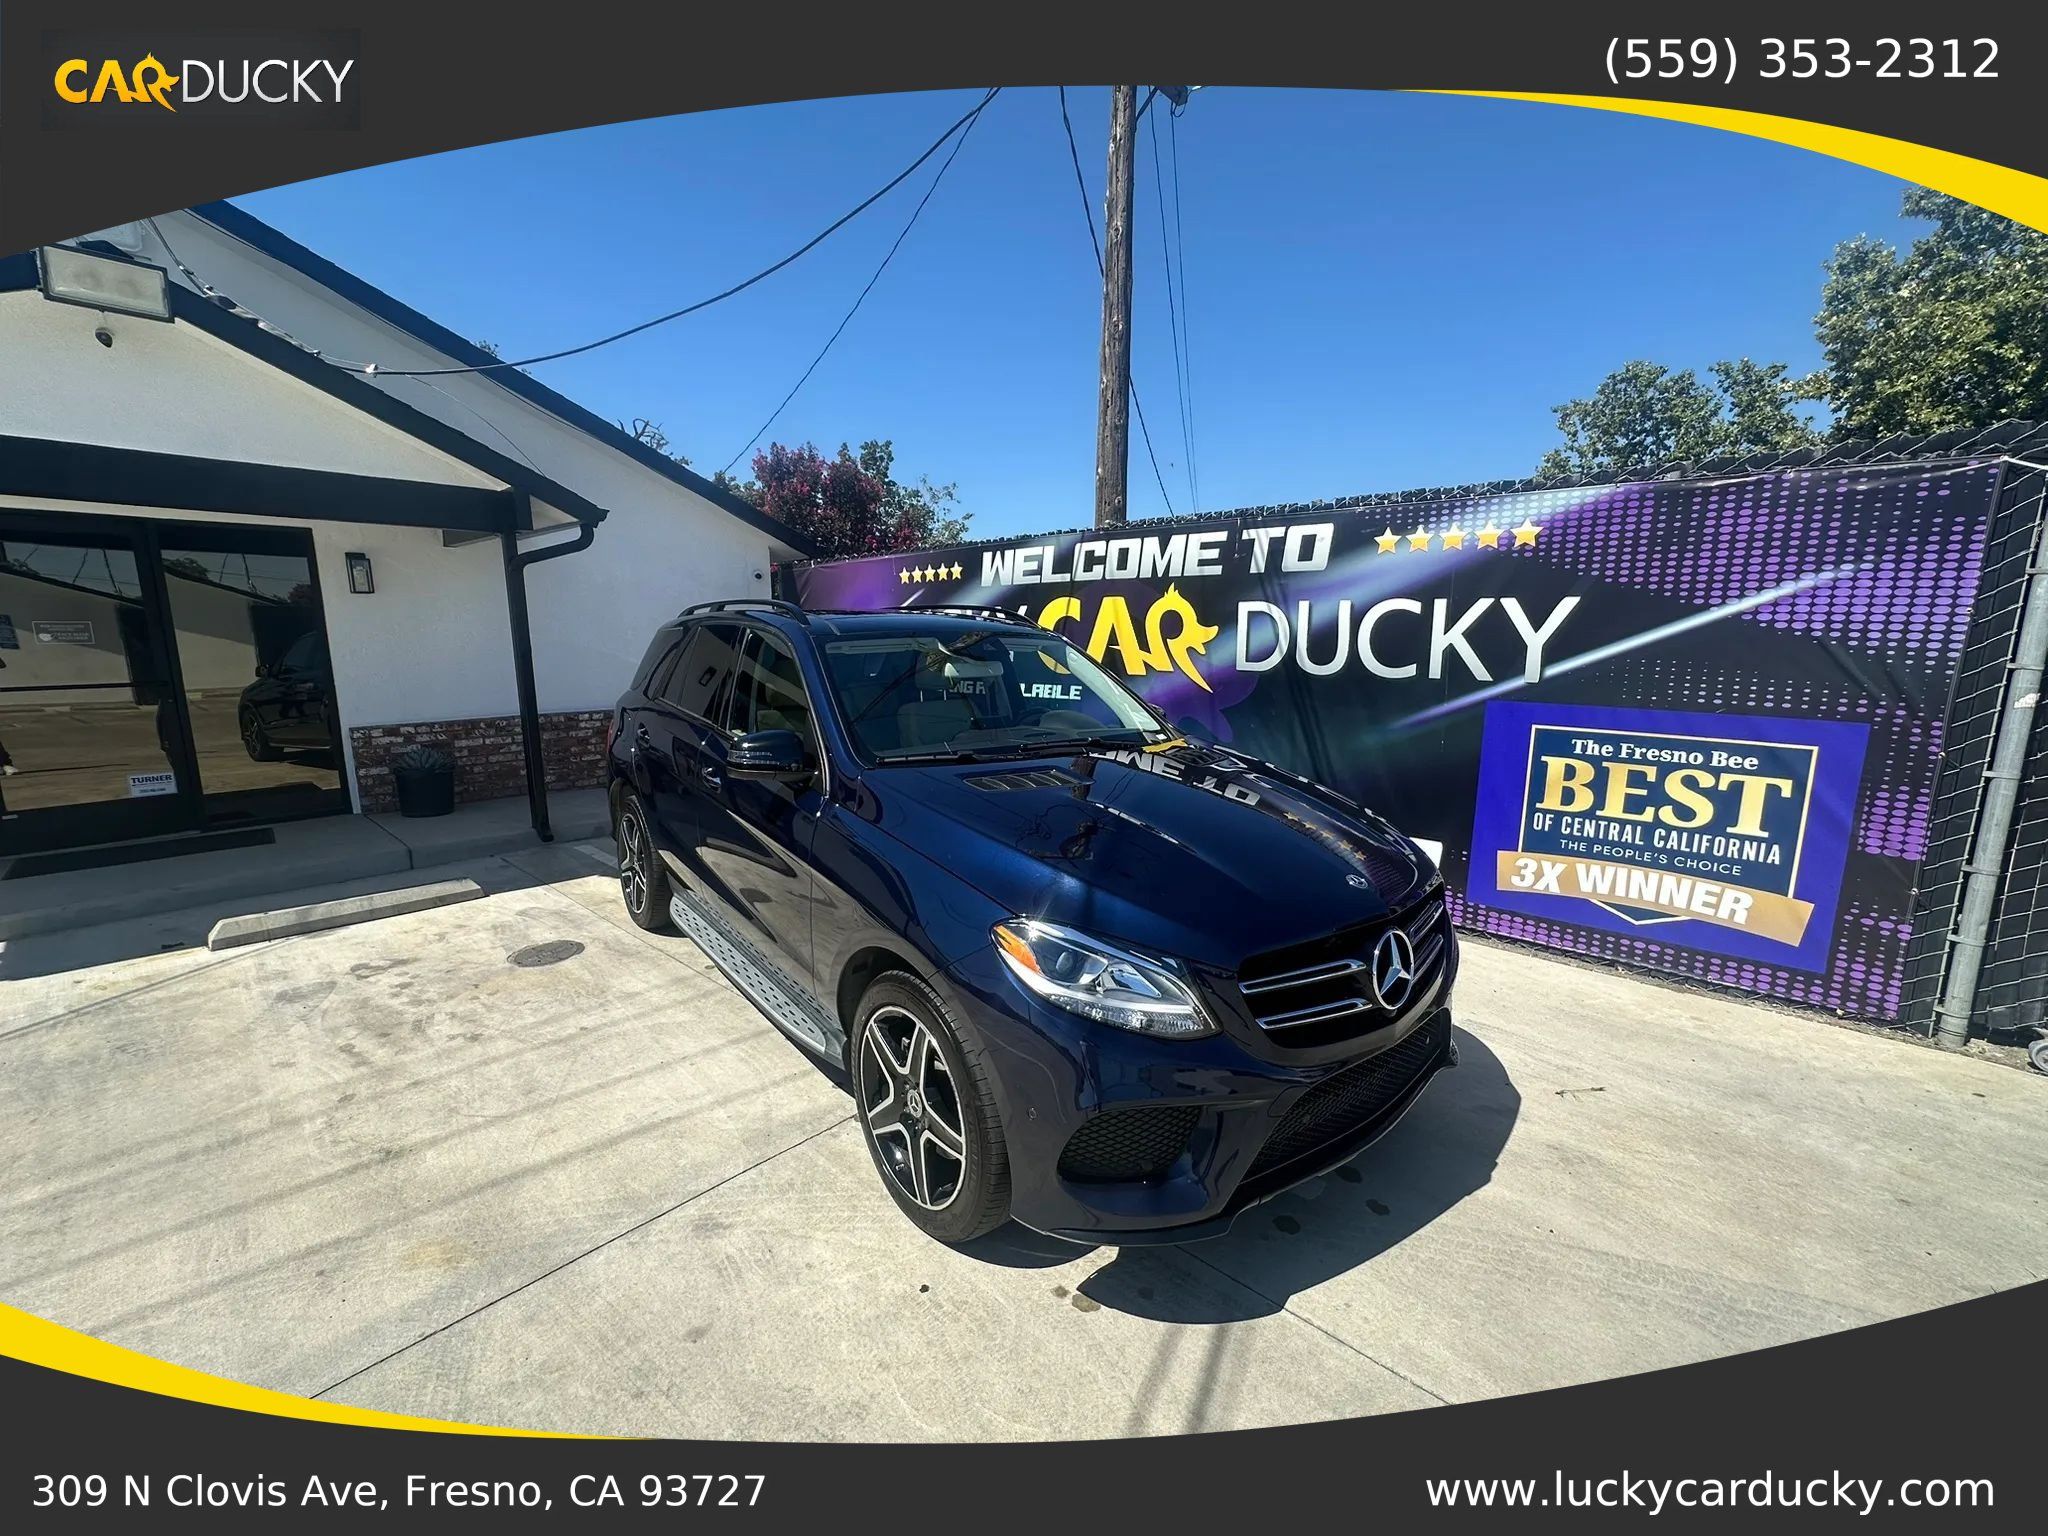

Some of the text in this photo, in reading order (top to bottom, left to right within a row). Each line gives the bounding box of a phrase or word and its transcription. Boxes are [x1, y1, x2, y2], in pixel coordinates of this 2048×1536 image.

[981, 522, 1334, 587] WELCOME TO
[1236, 596, 1581, 683] DUCKY
[131, 774, 172, 784] TURNER
[1572, 738, 1759, 770] The Fresno Bee
[1535, 755, 1793, 838] BEST
[1533, 812, 1781, 865] OF CENTRAL CALIFORNIA
[1560, 839, 1742, 876] THE PEOPLE'S CHOICE
[1510, 857, 1754, 925] 3X WINNER
